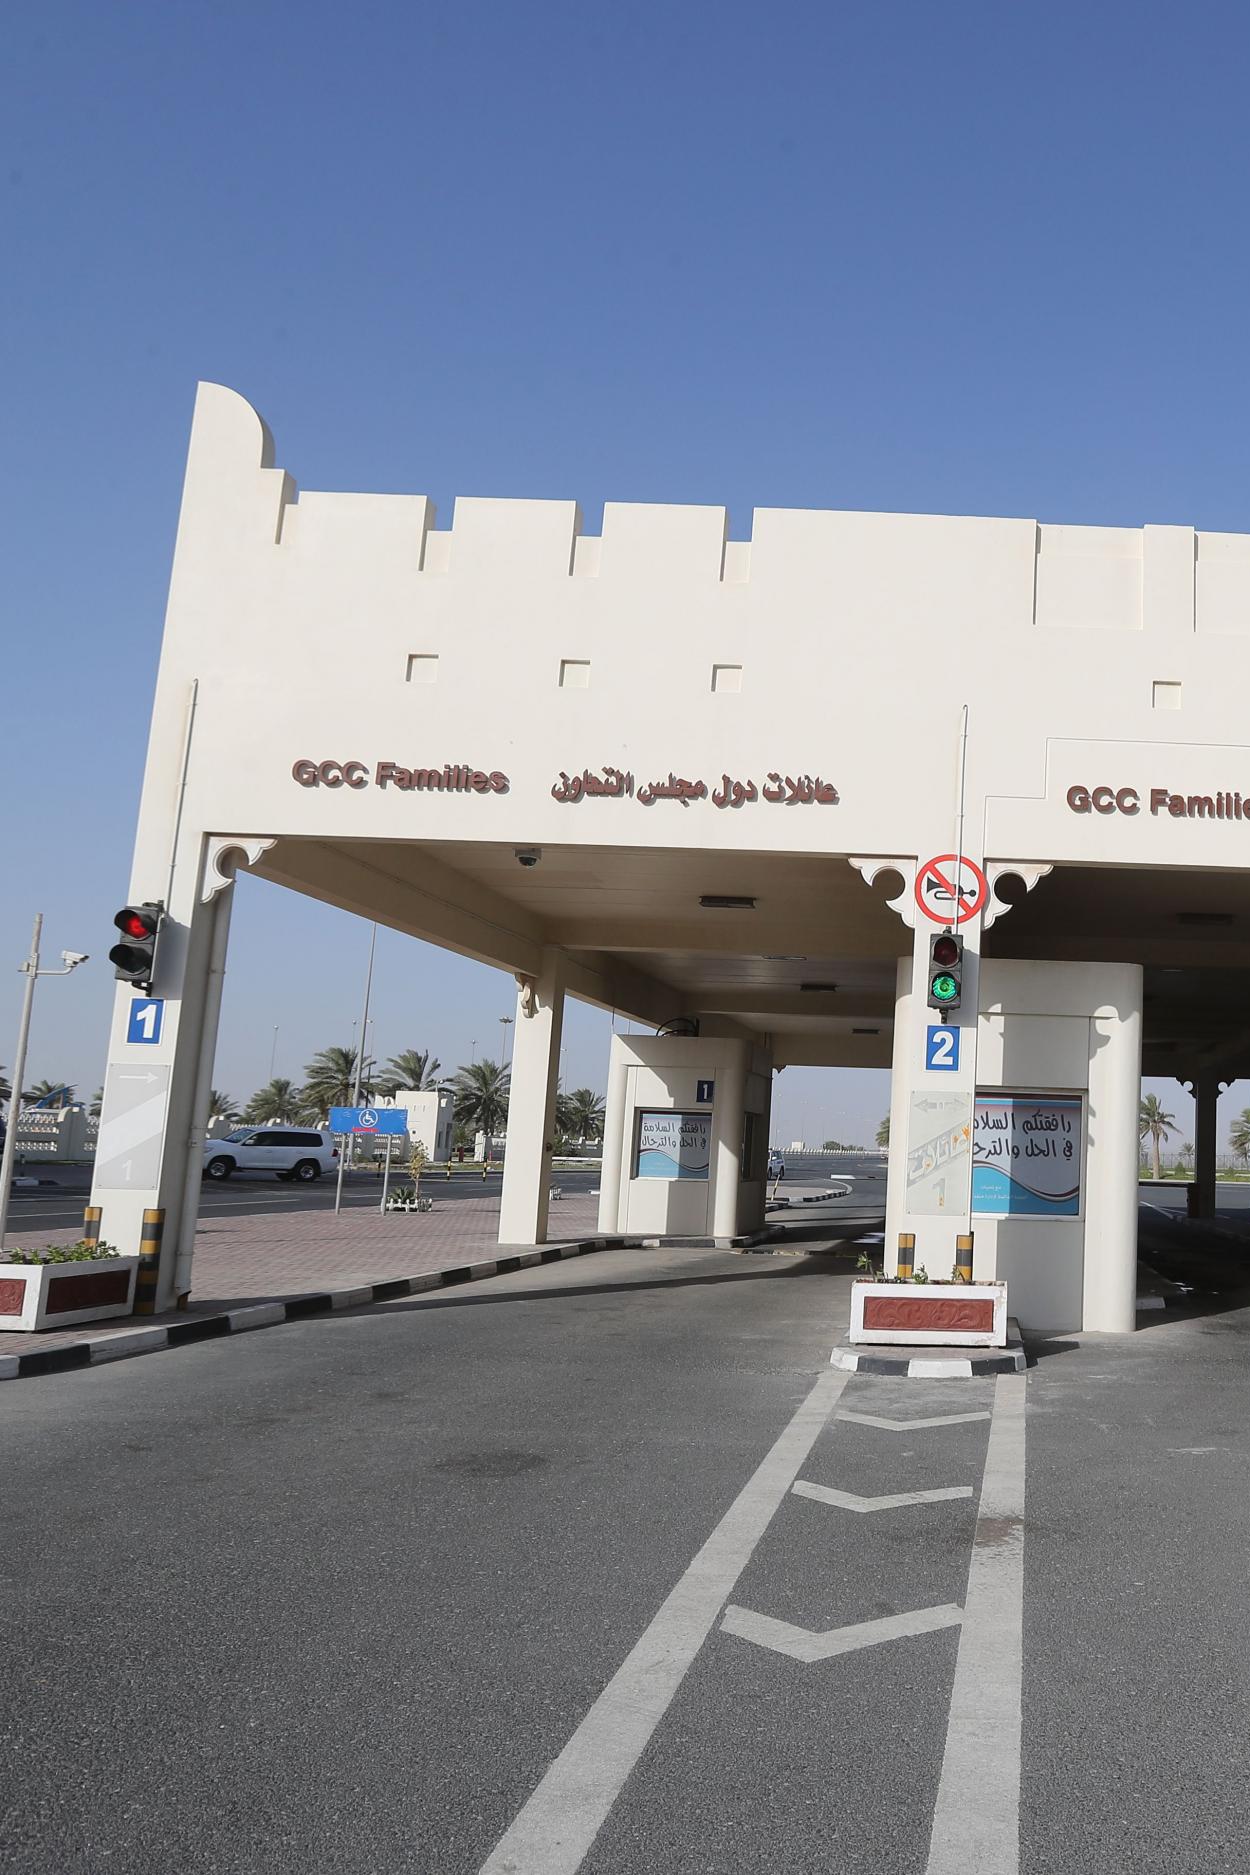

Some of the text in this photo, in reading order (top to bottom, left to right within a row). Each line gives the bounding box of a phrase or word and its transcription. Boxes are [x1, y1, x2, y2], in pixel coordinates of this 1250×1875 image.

[291, 759, 510, 794] GCC Families
[551, 766, 840, 809] عائلات دول مجلس التعاون
[1066, 785, 1141, 816] GCC
[136, 1004, 157, 1038] 1
[931, 1031, 954, 1065] 2
[702, 1084, 709, 1099] 1
[973, 1111, 1016, 1131] السلام
[973, 1137, 1073, 1161] في الحل والترح
[122, 1159, 133, 1181] 1
